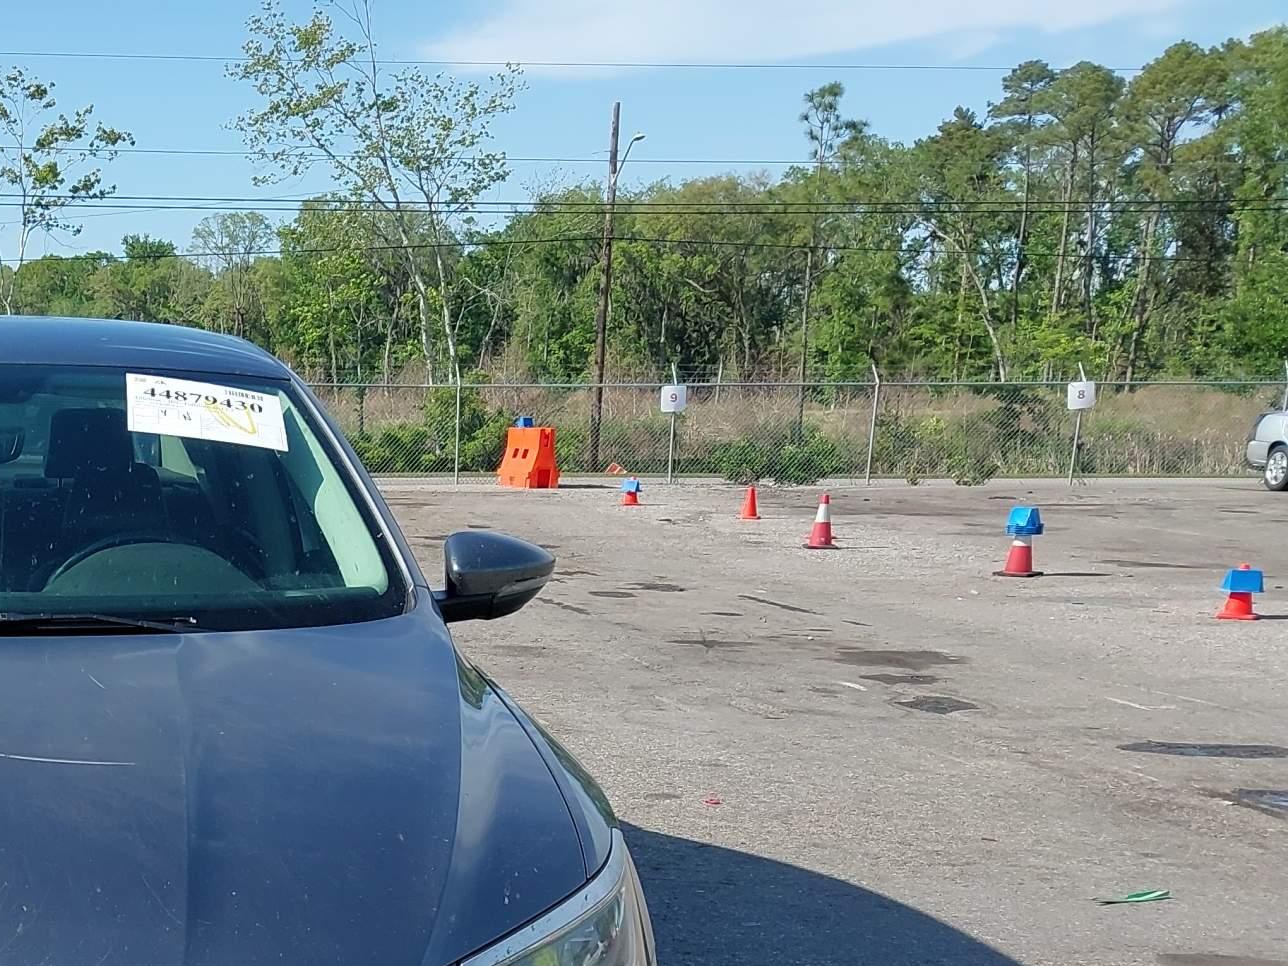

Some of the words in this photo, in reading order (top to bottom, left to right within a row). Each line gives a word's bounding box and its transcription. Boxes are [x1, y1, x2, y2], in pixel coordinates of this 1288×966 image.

[670, 393, 678, 403] 9
[1077, 389, 1086, 400] 8
[143, 387, 263, 414] 44879430
